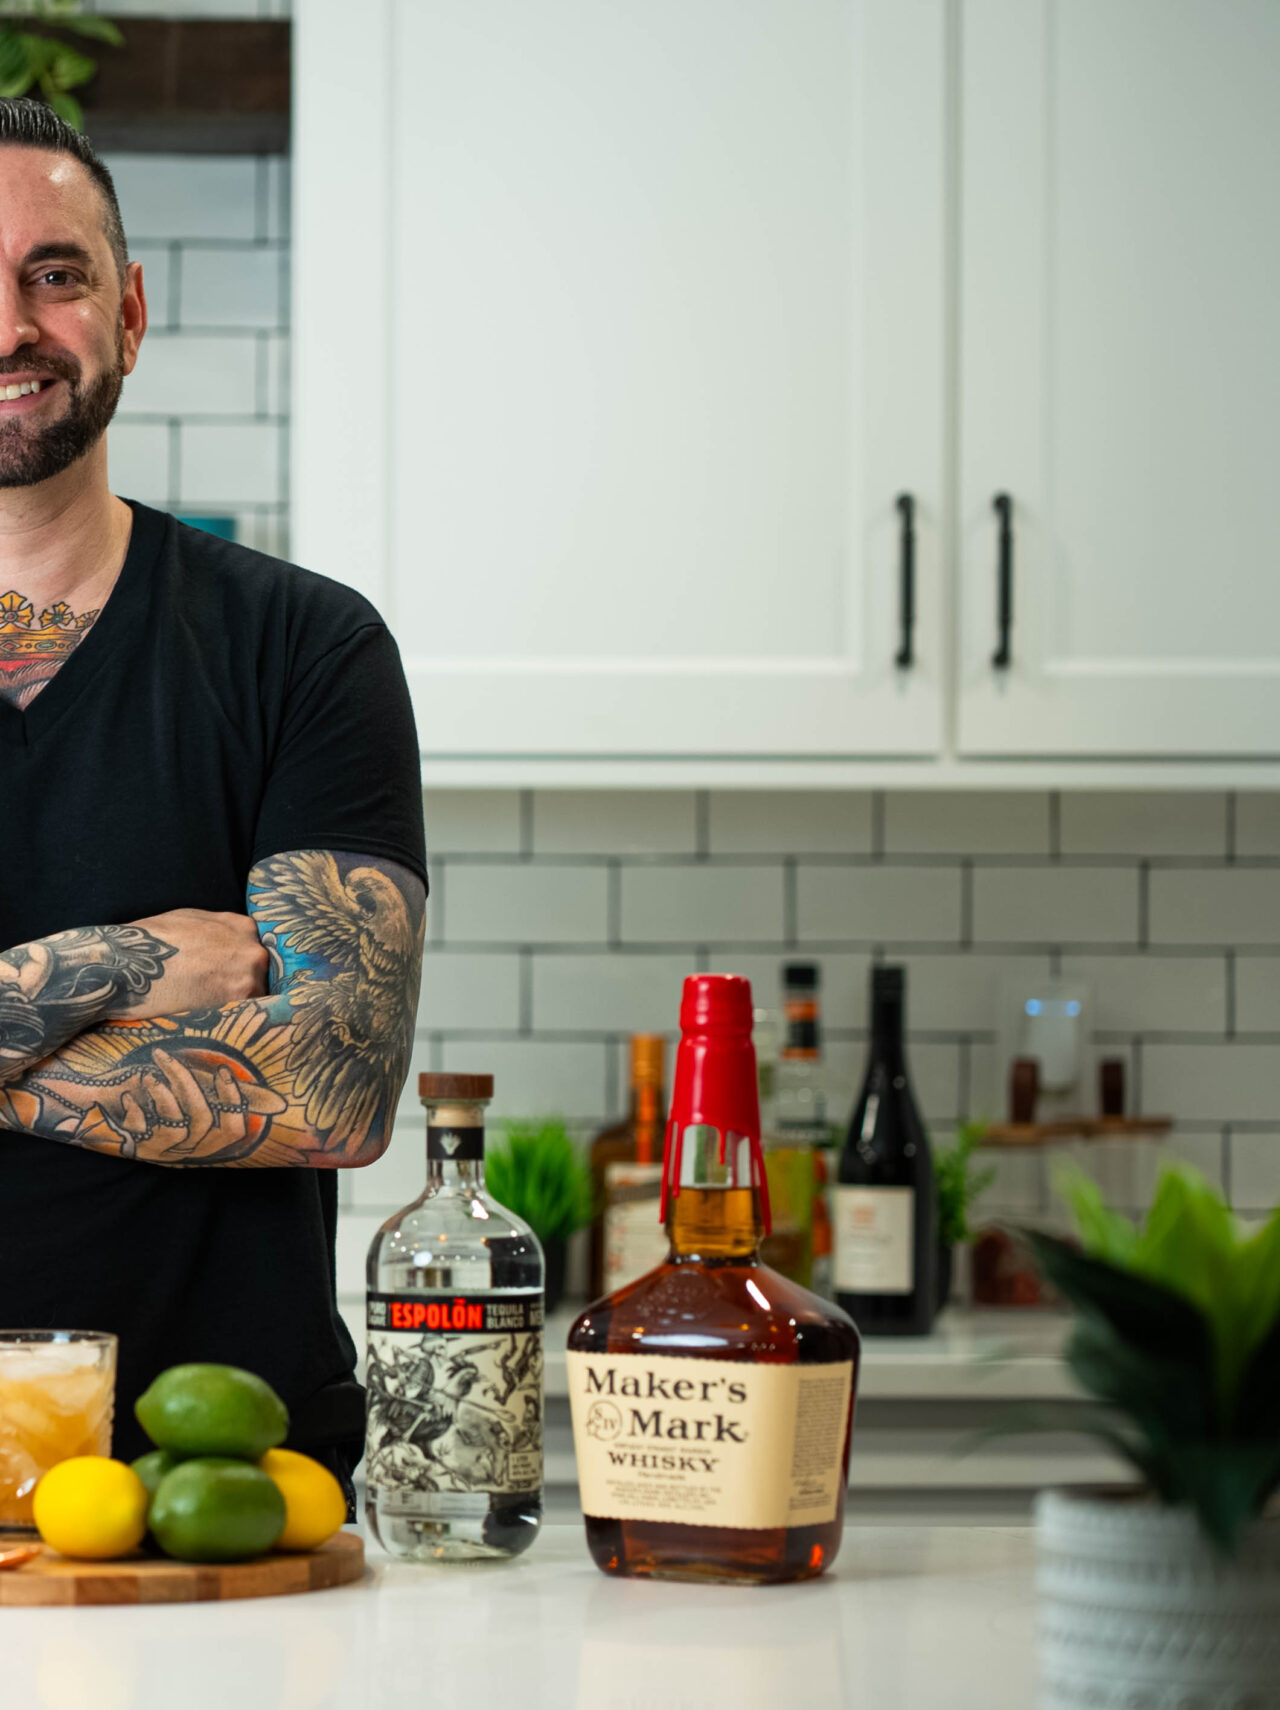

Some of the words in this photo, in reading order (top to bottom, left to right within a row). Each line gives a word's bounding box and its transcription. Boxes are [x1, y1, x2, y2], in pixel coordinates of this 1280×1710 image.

[486, 1302, 524, 1316] TEQUILA
[486, 1316, 524, 1330] BLANCO
[584, 1366, 748, 1404] Maker's
[627, 1408, 745, 1443] Mark
[607, 1450, 720, 1473] WHISKY
